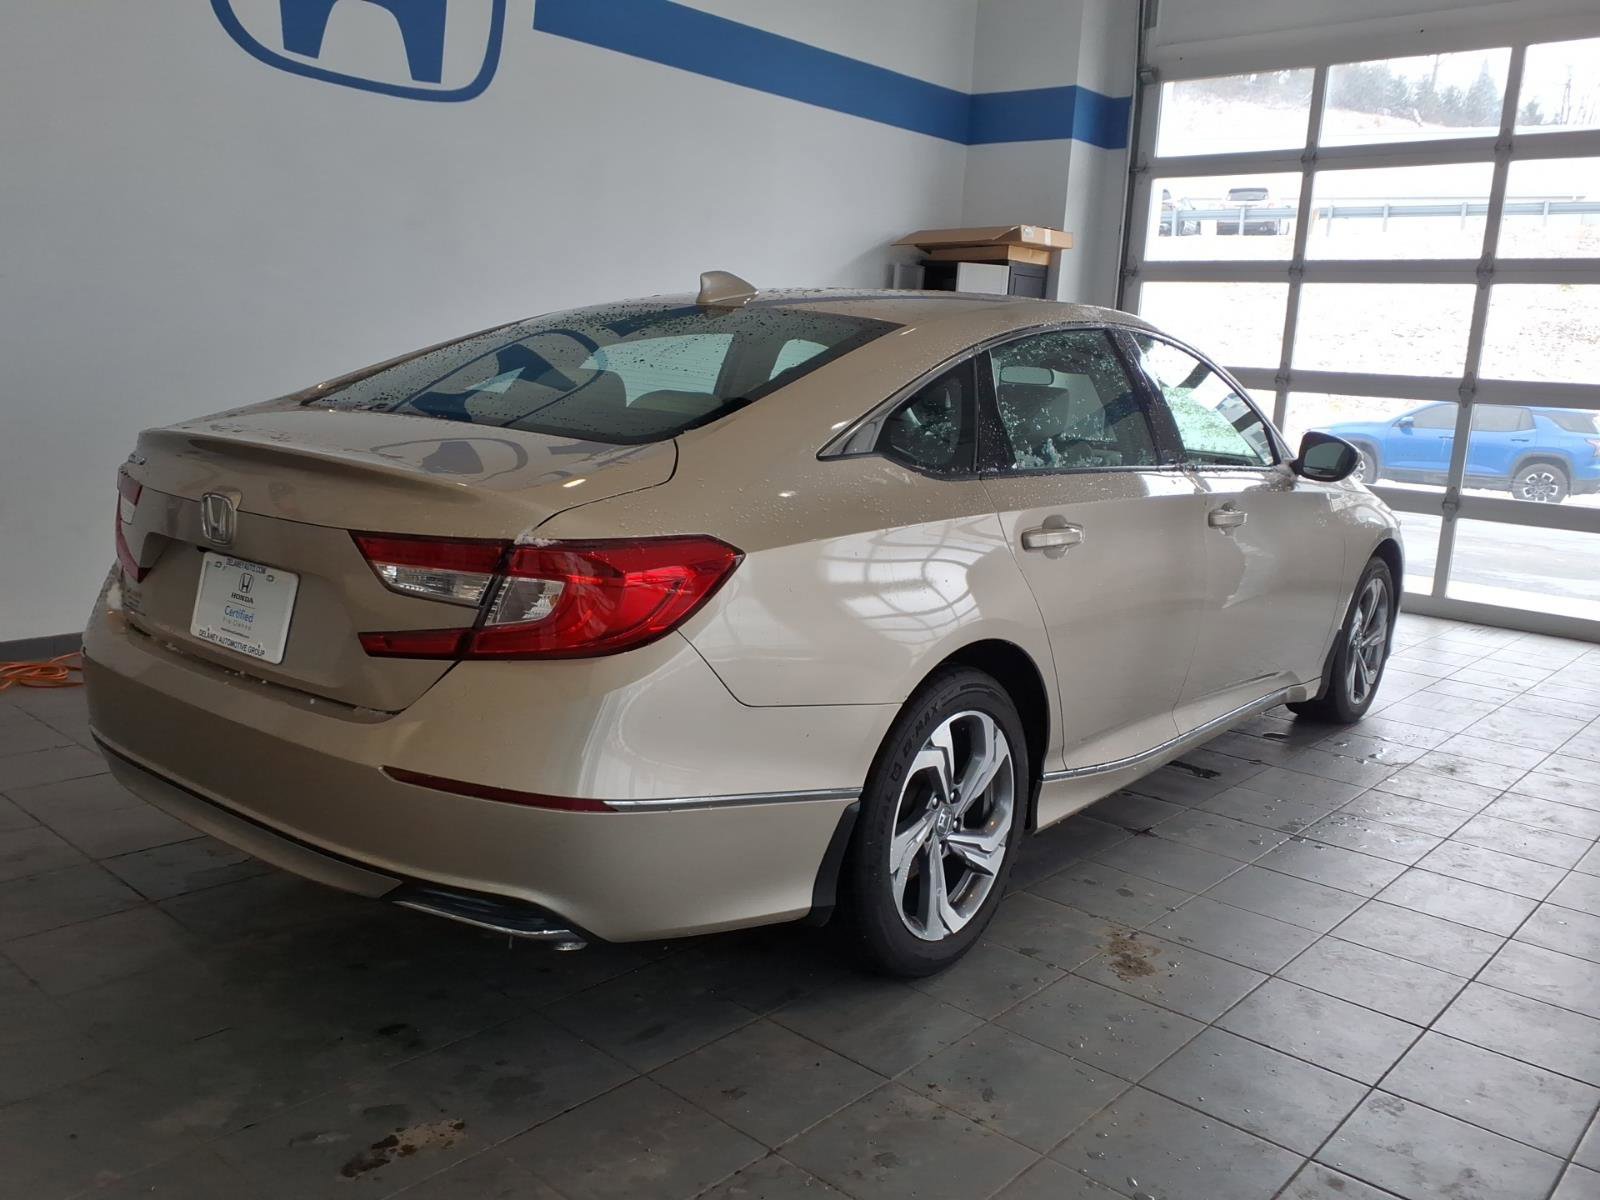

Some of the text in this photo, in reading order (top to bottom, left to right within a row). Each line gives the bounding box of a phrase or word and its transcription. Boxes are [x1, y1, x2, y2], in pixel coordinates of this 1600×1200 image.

[231, 592, 254, 604] HONDA
[224, 605, 254, 623] Certified
[199, 629, 265, 656] DELANEY AUTOMOTIVE GROUP
